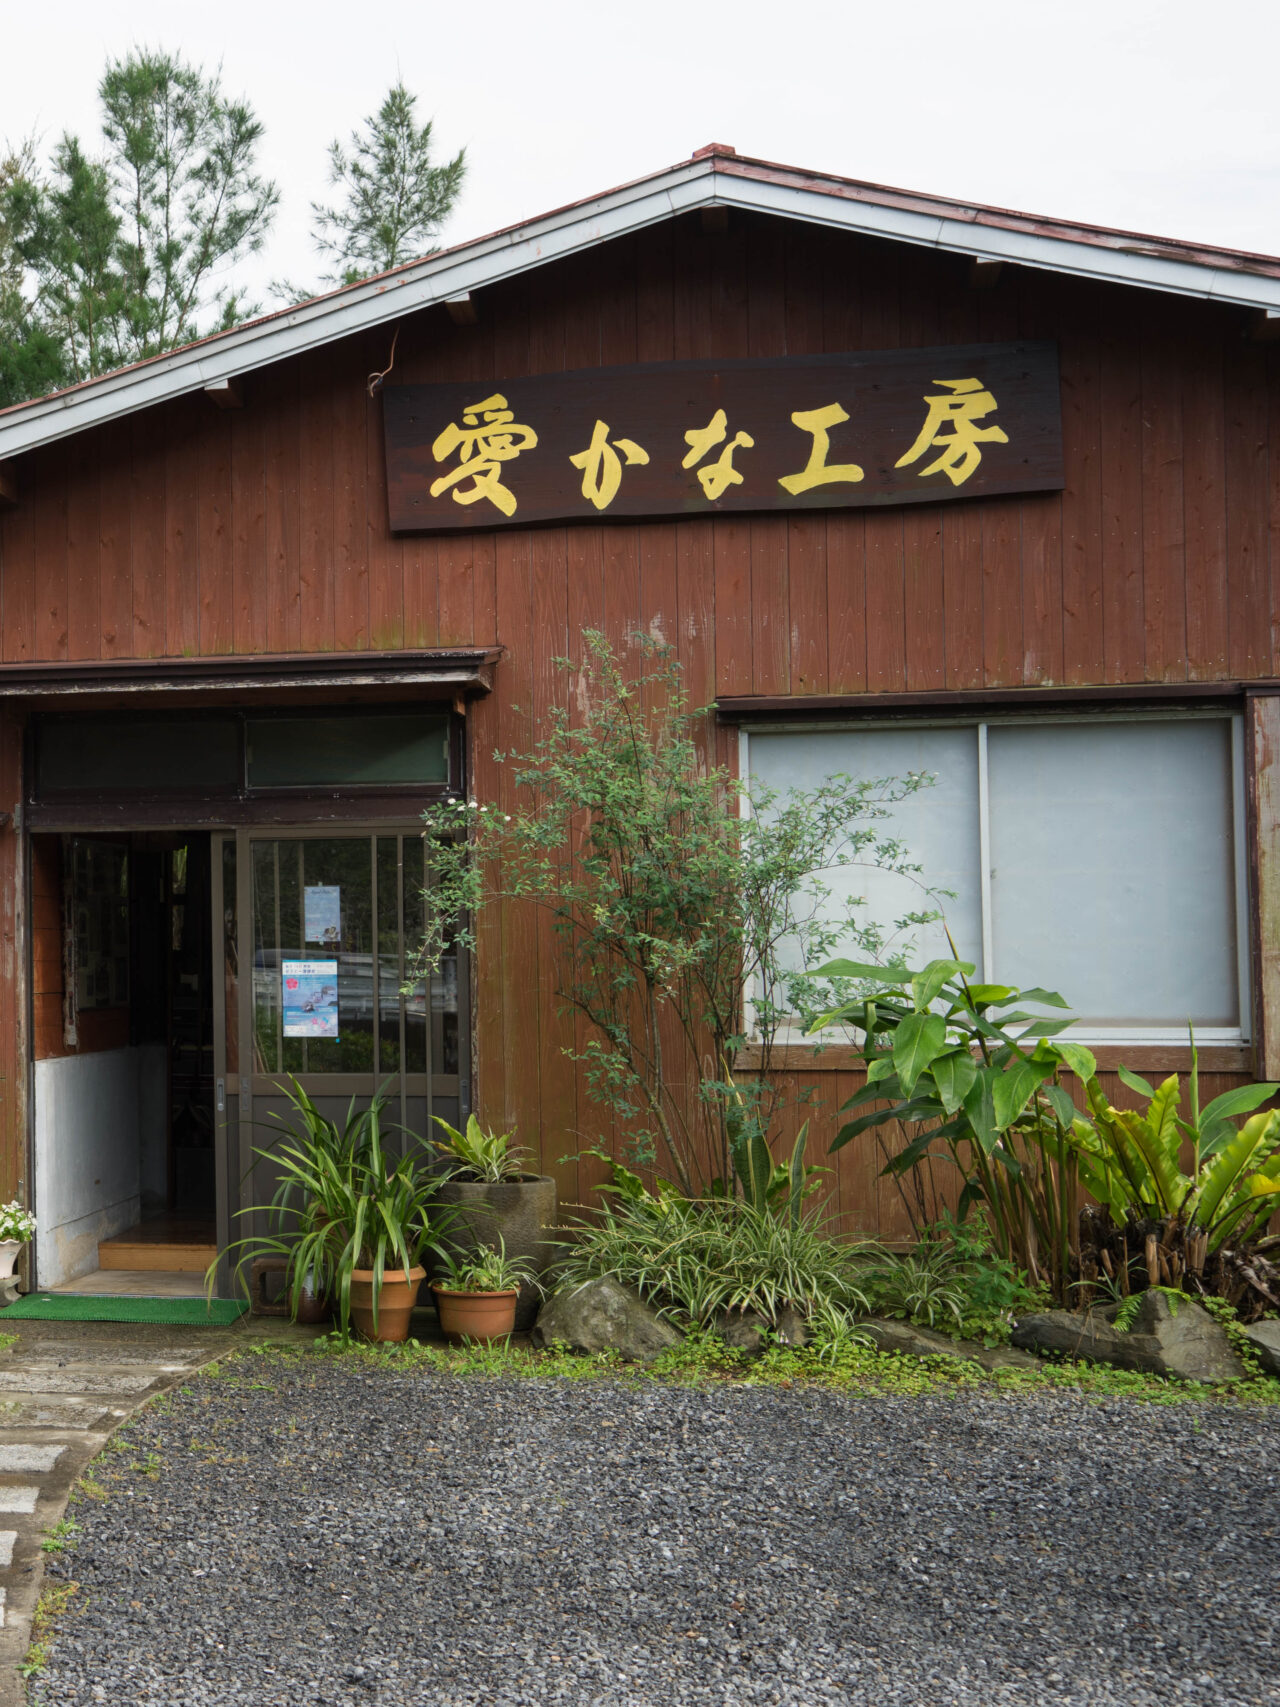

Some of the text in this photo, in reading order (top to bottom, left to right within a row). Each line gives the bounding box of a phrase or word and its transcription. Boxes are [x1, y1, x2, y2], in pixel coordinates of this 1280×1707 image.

[429, 377, 1009, 517] 愛かな工房
